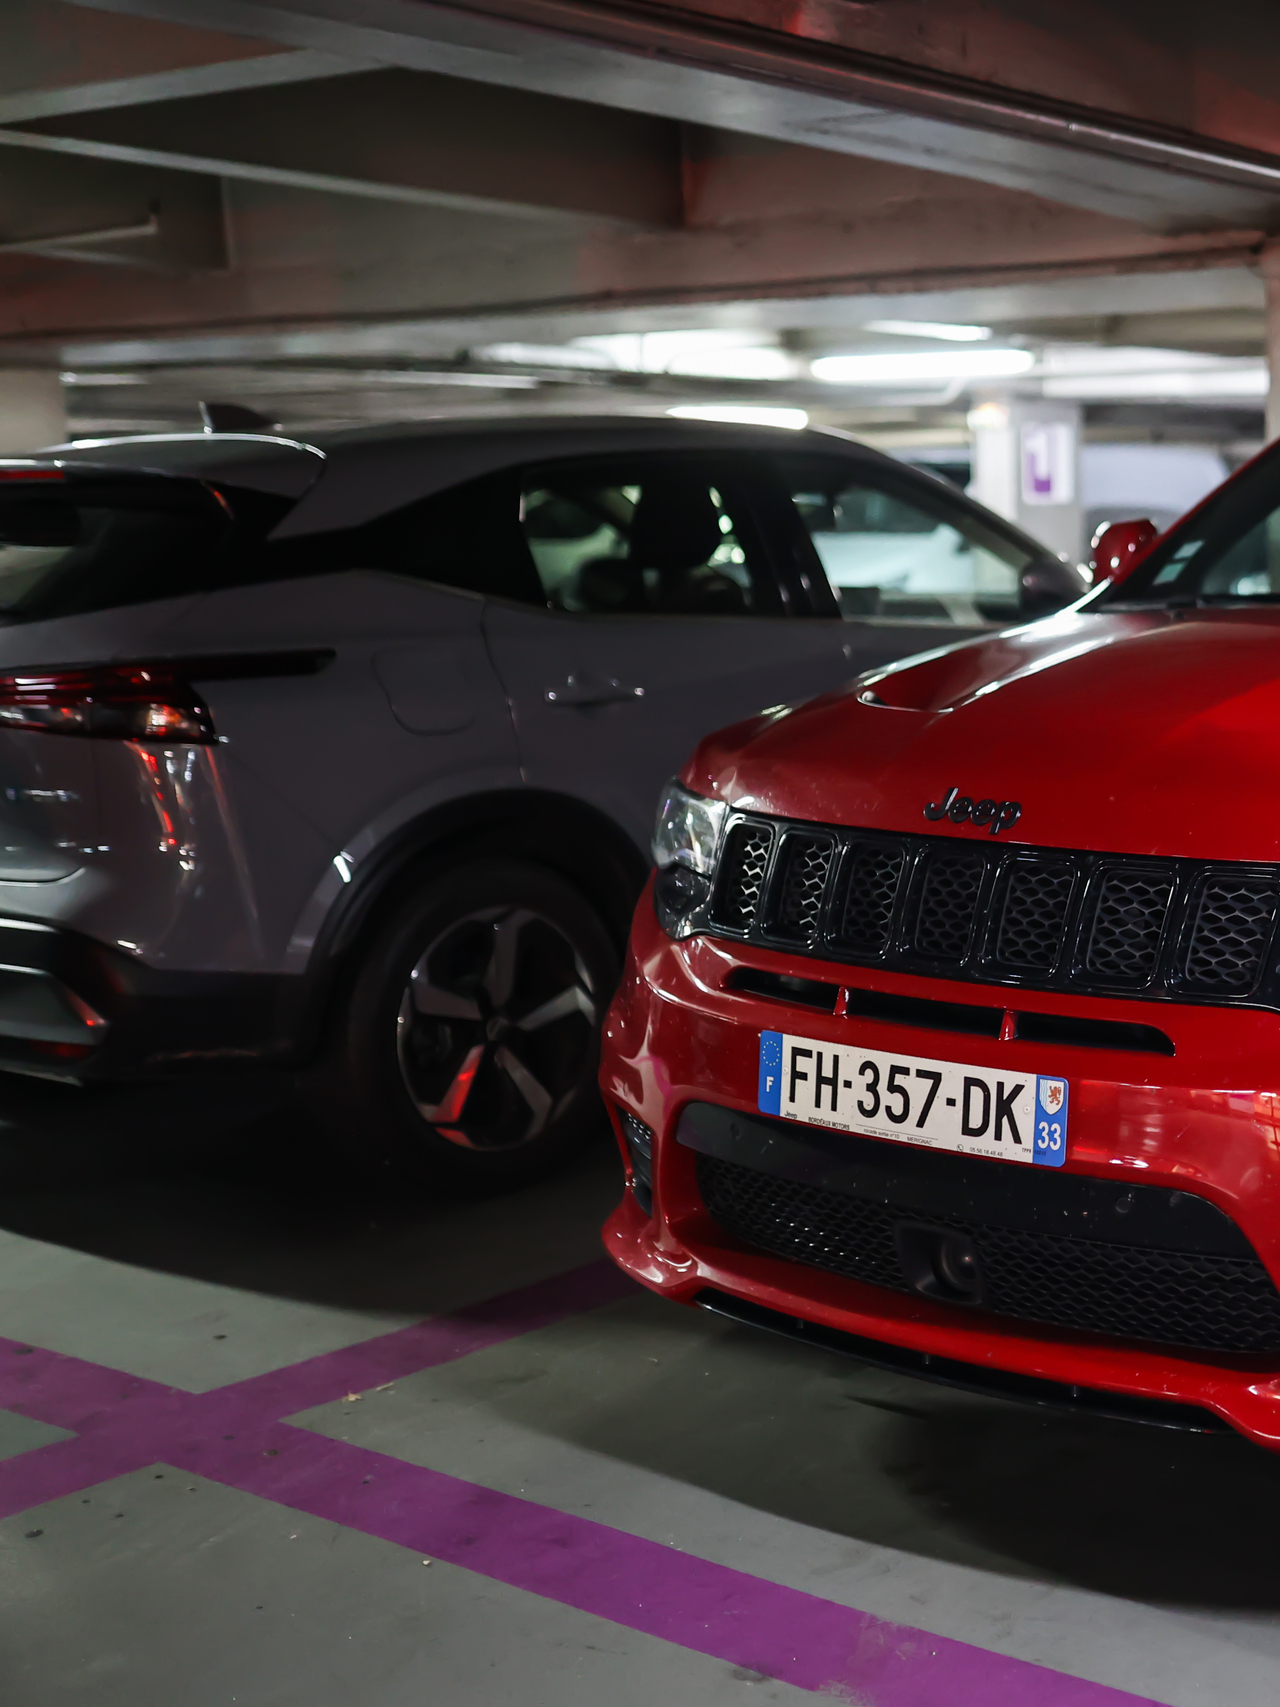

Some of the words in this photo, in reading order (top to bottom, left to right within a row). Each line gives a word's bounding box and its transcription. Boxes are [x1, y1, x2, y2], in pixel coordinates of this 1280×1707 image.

[923, 786, 1022, 836] Jeep
[765, 1076, 775, 1093] F
[788, 1045, 1026, 1145] FH-357-DK
[784, 1110, 798, 1120] Jeep
[831, 1121, 850, 1131] MOTORS
[1037, 1121, 1062, 1151] 33
